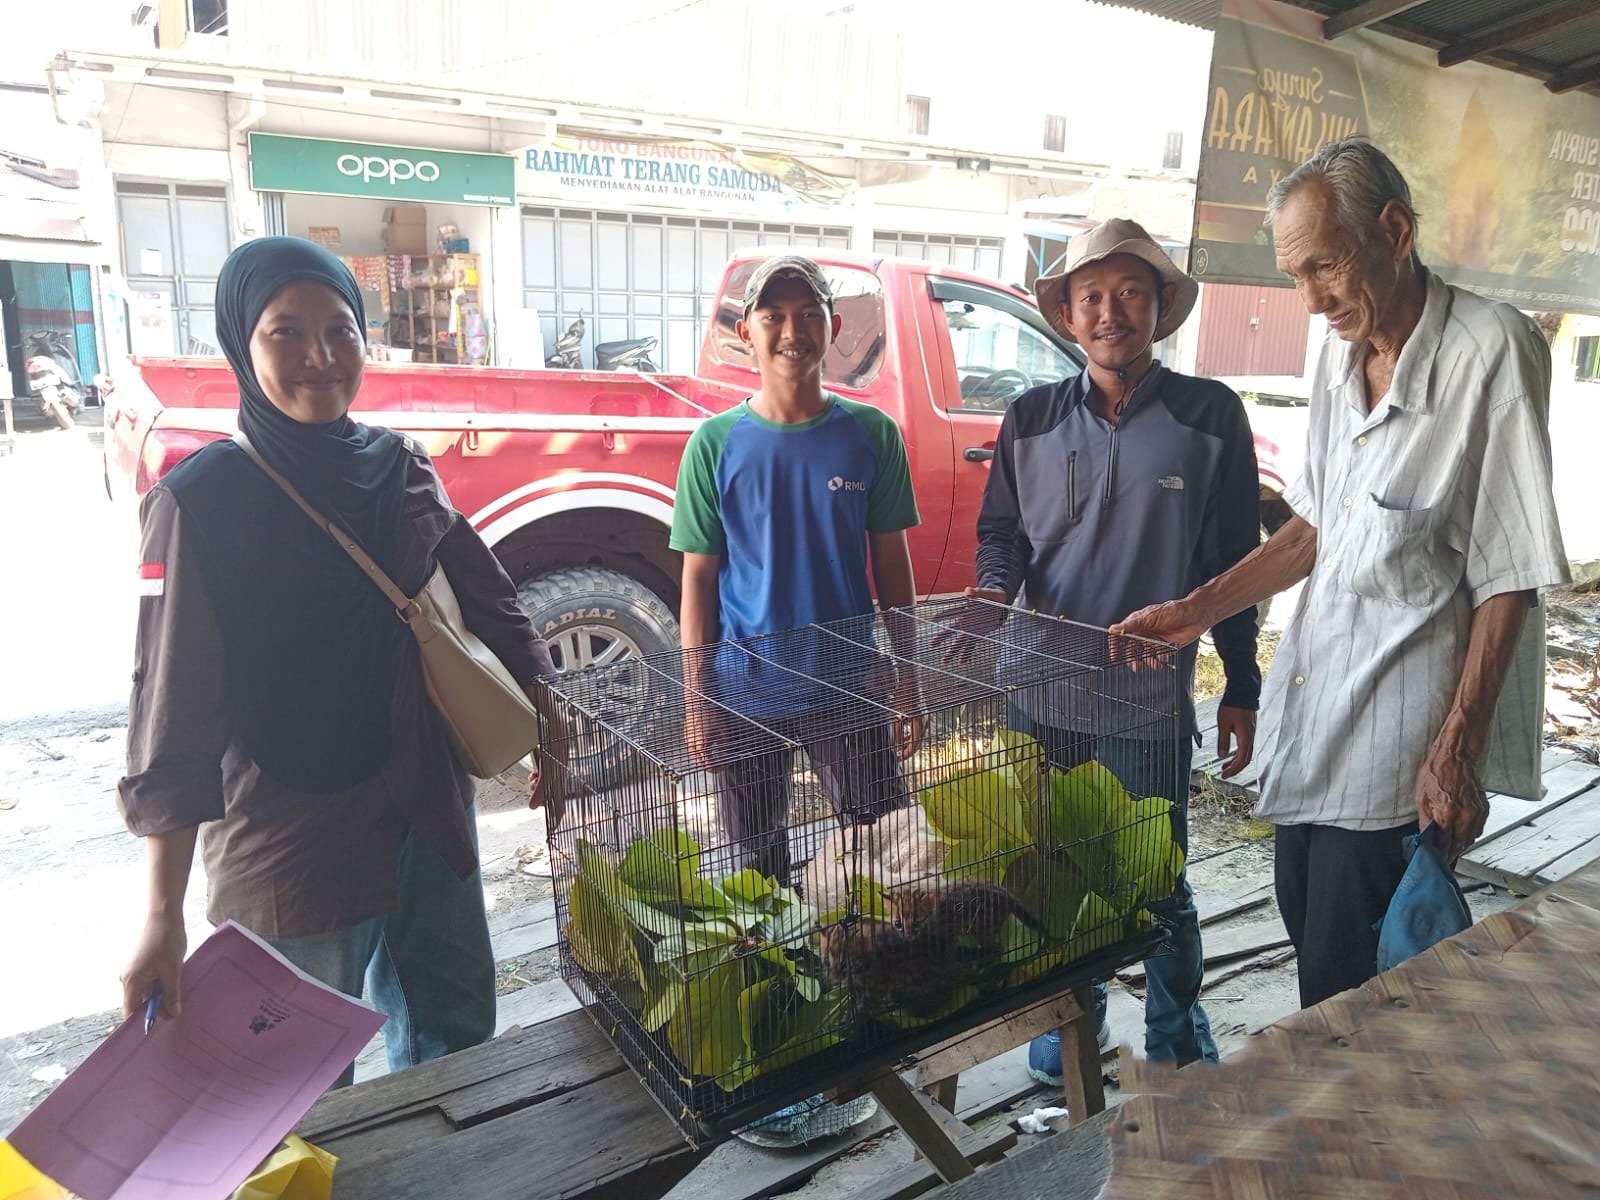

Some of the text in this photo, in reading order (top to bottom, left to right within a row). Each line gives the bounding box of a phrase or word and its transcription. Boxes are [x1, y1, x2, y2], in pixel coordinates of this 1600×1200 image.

[576, 138, 741, 165] TOKO BANGUNA
[525, 148, 784, 194] RAHMAT TERANG SAMUDA
[560, 176, 641, 192] MENYEDIAKAN
[700, 188, 756, 202] BANGUNAN
[542, 607, 616, 636] ADIAL
